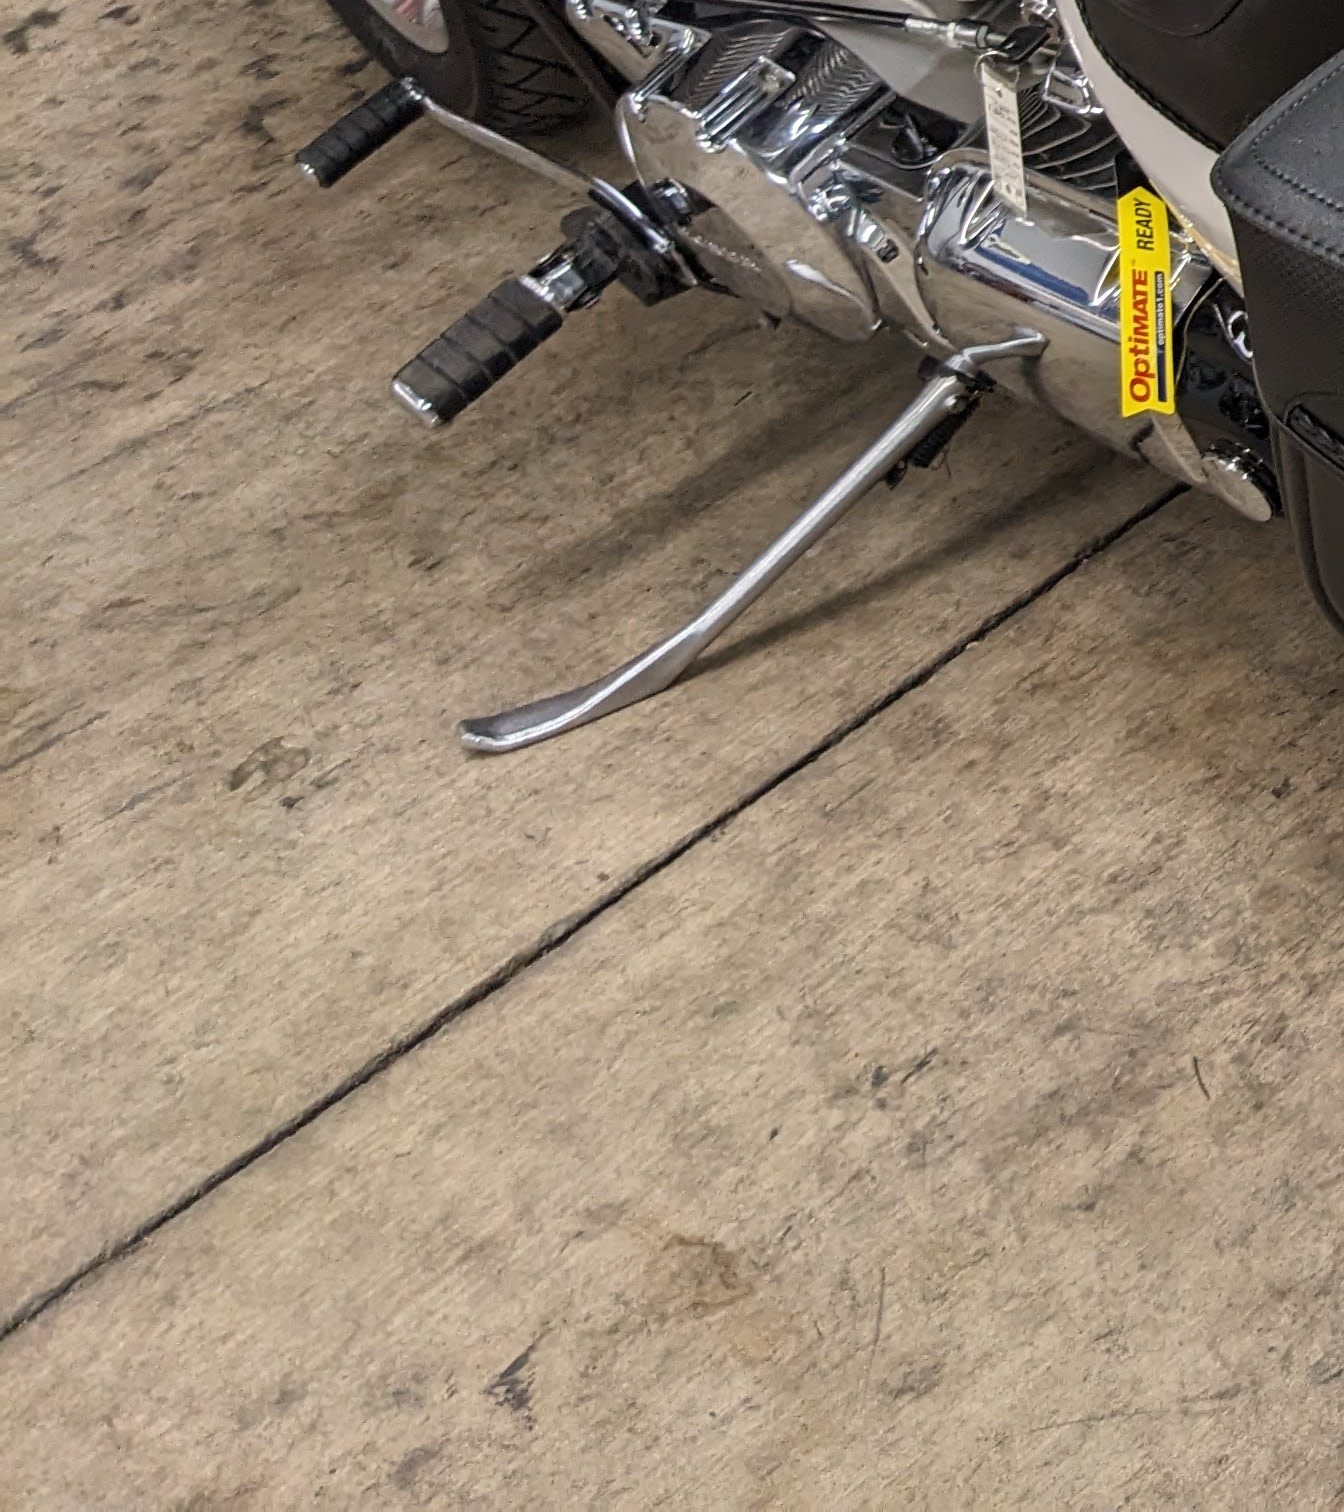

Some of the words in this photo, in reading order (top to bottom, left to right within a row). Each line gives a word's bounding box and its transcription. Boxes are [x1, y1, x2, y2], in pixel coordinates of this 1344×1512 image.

[1134, 197, 1156, 252] READY
[1129, 270, 1156, 402] OptiMATE
[1155, 272, 1167, 346] optimate1.com
